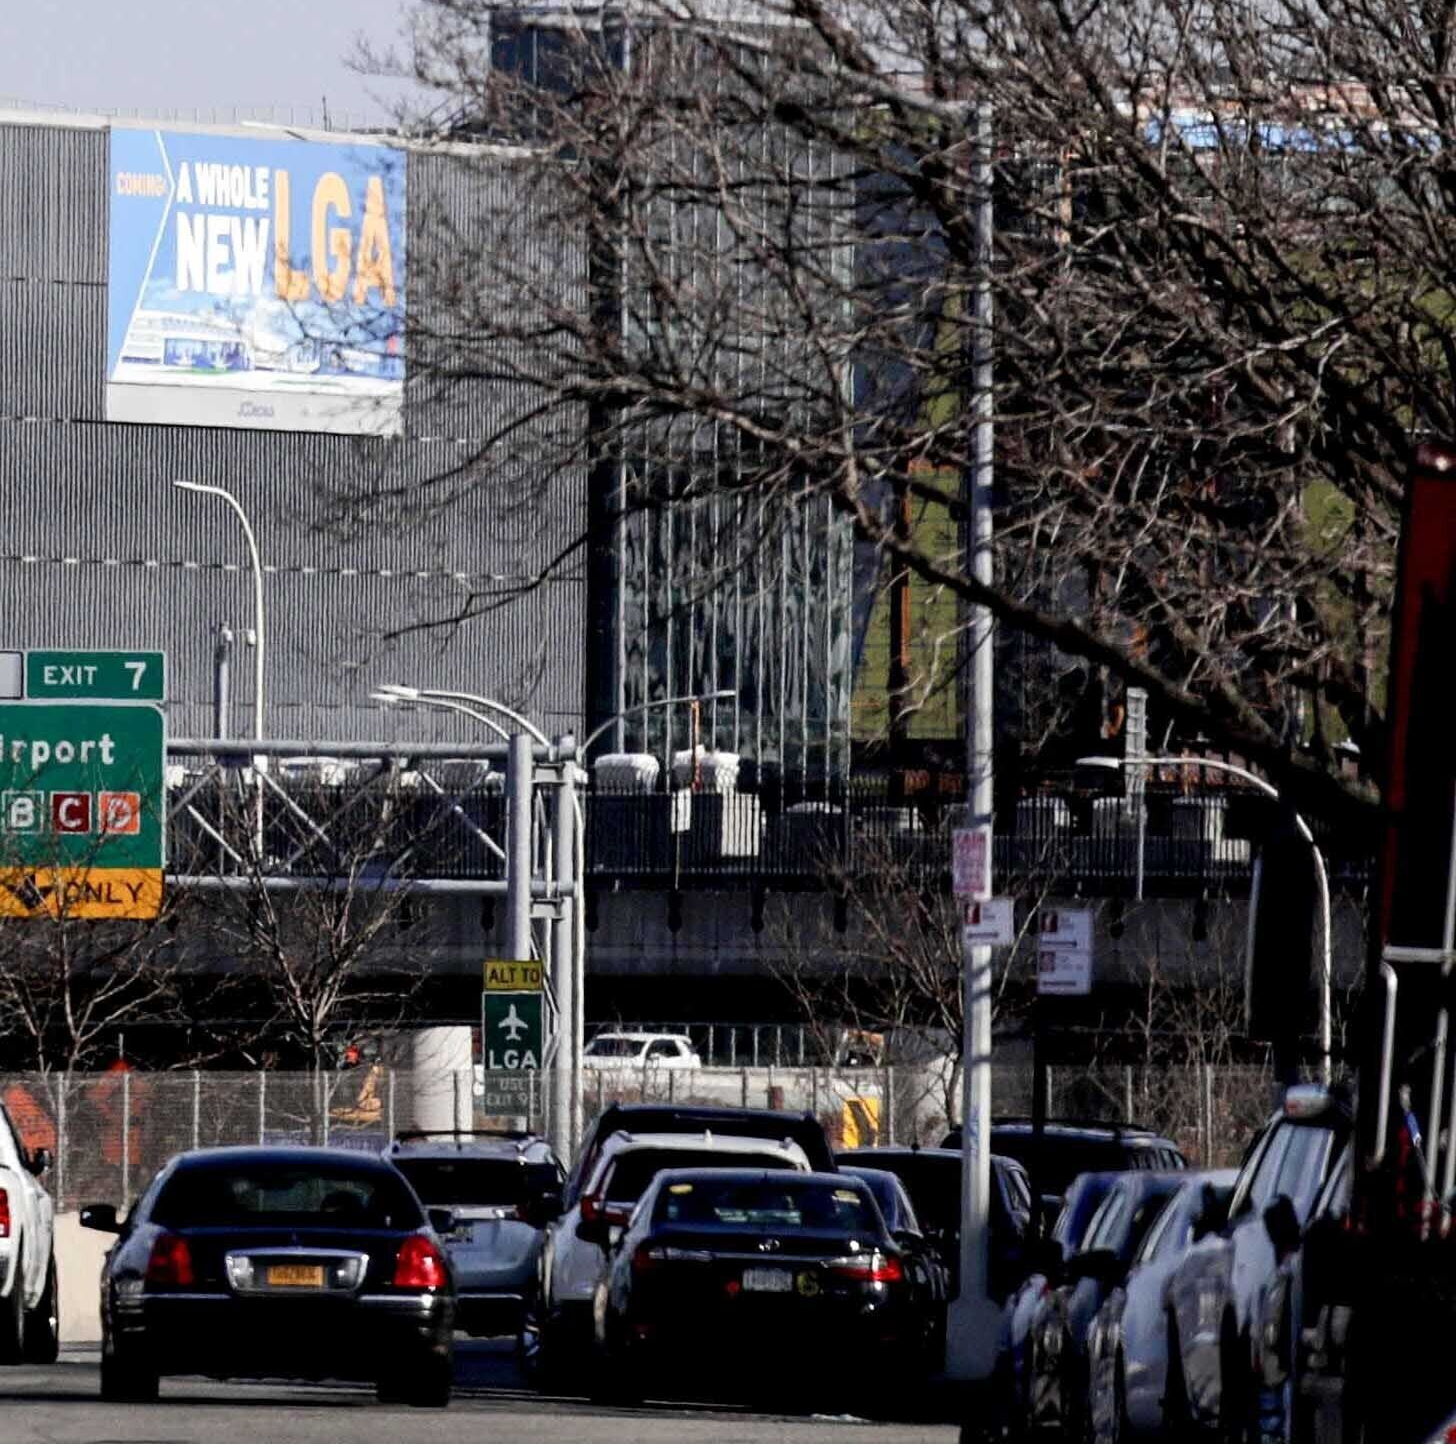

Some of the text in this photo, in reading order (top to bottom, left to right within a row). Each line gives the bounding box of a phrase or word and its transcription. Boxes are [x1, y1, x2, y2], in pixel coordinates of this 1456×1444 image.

[176, 161, 269, 210] A WHOLE
[175, 212, 270, 294] NEW
[273, 169, 398, 308] LGA
[43, 661, 148, 690] EXIT 7
[10, 797, 36, 828] B
[57, 797, 83, 829] C
[106, 796, 133, 829] D
[64, 880, 145, 905] ONLY
[489, 967, 541, 984] ALT TO
[488, 1049, 538, 1070] LGA
